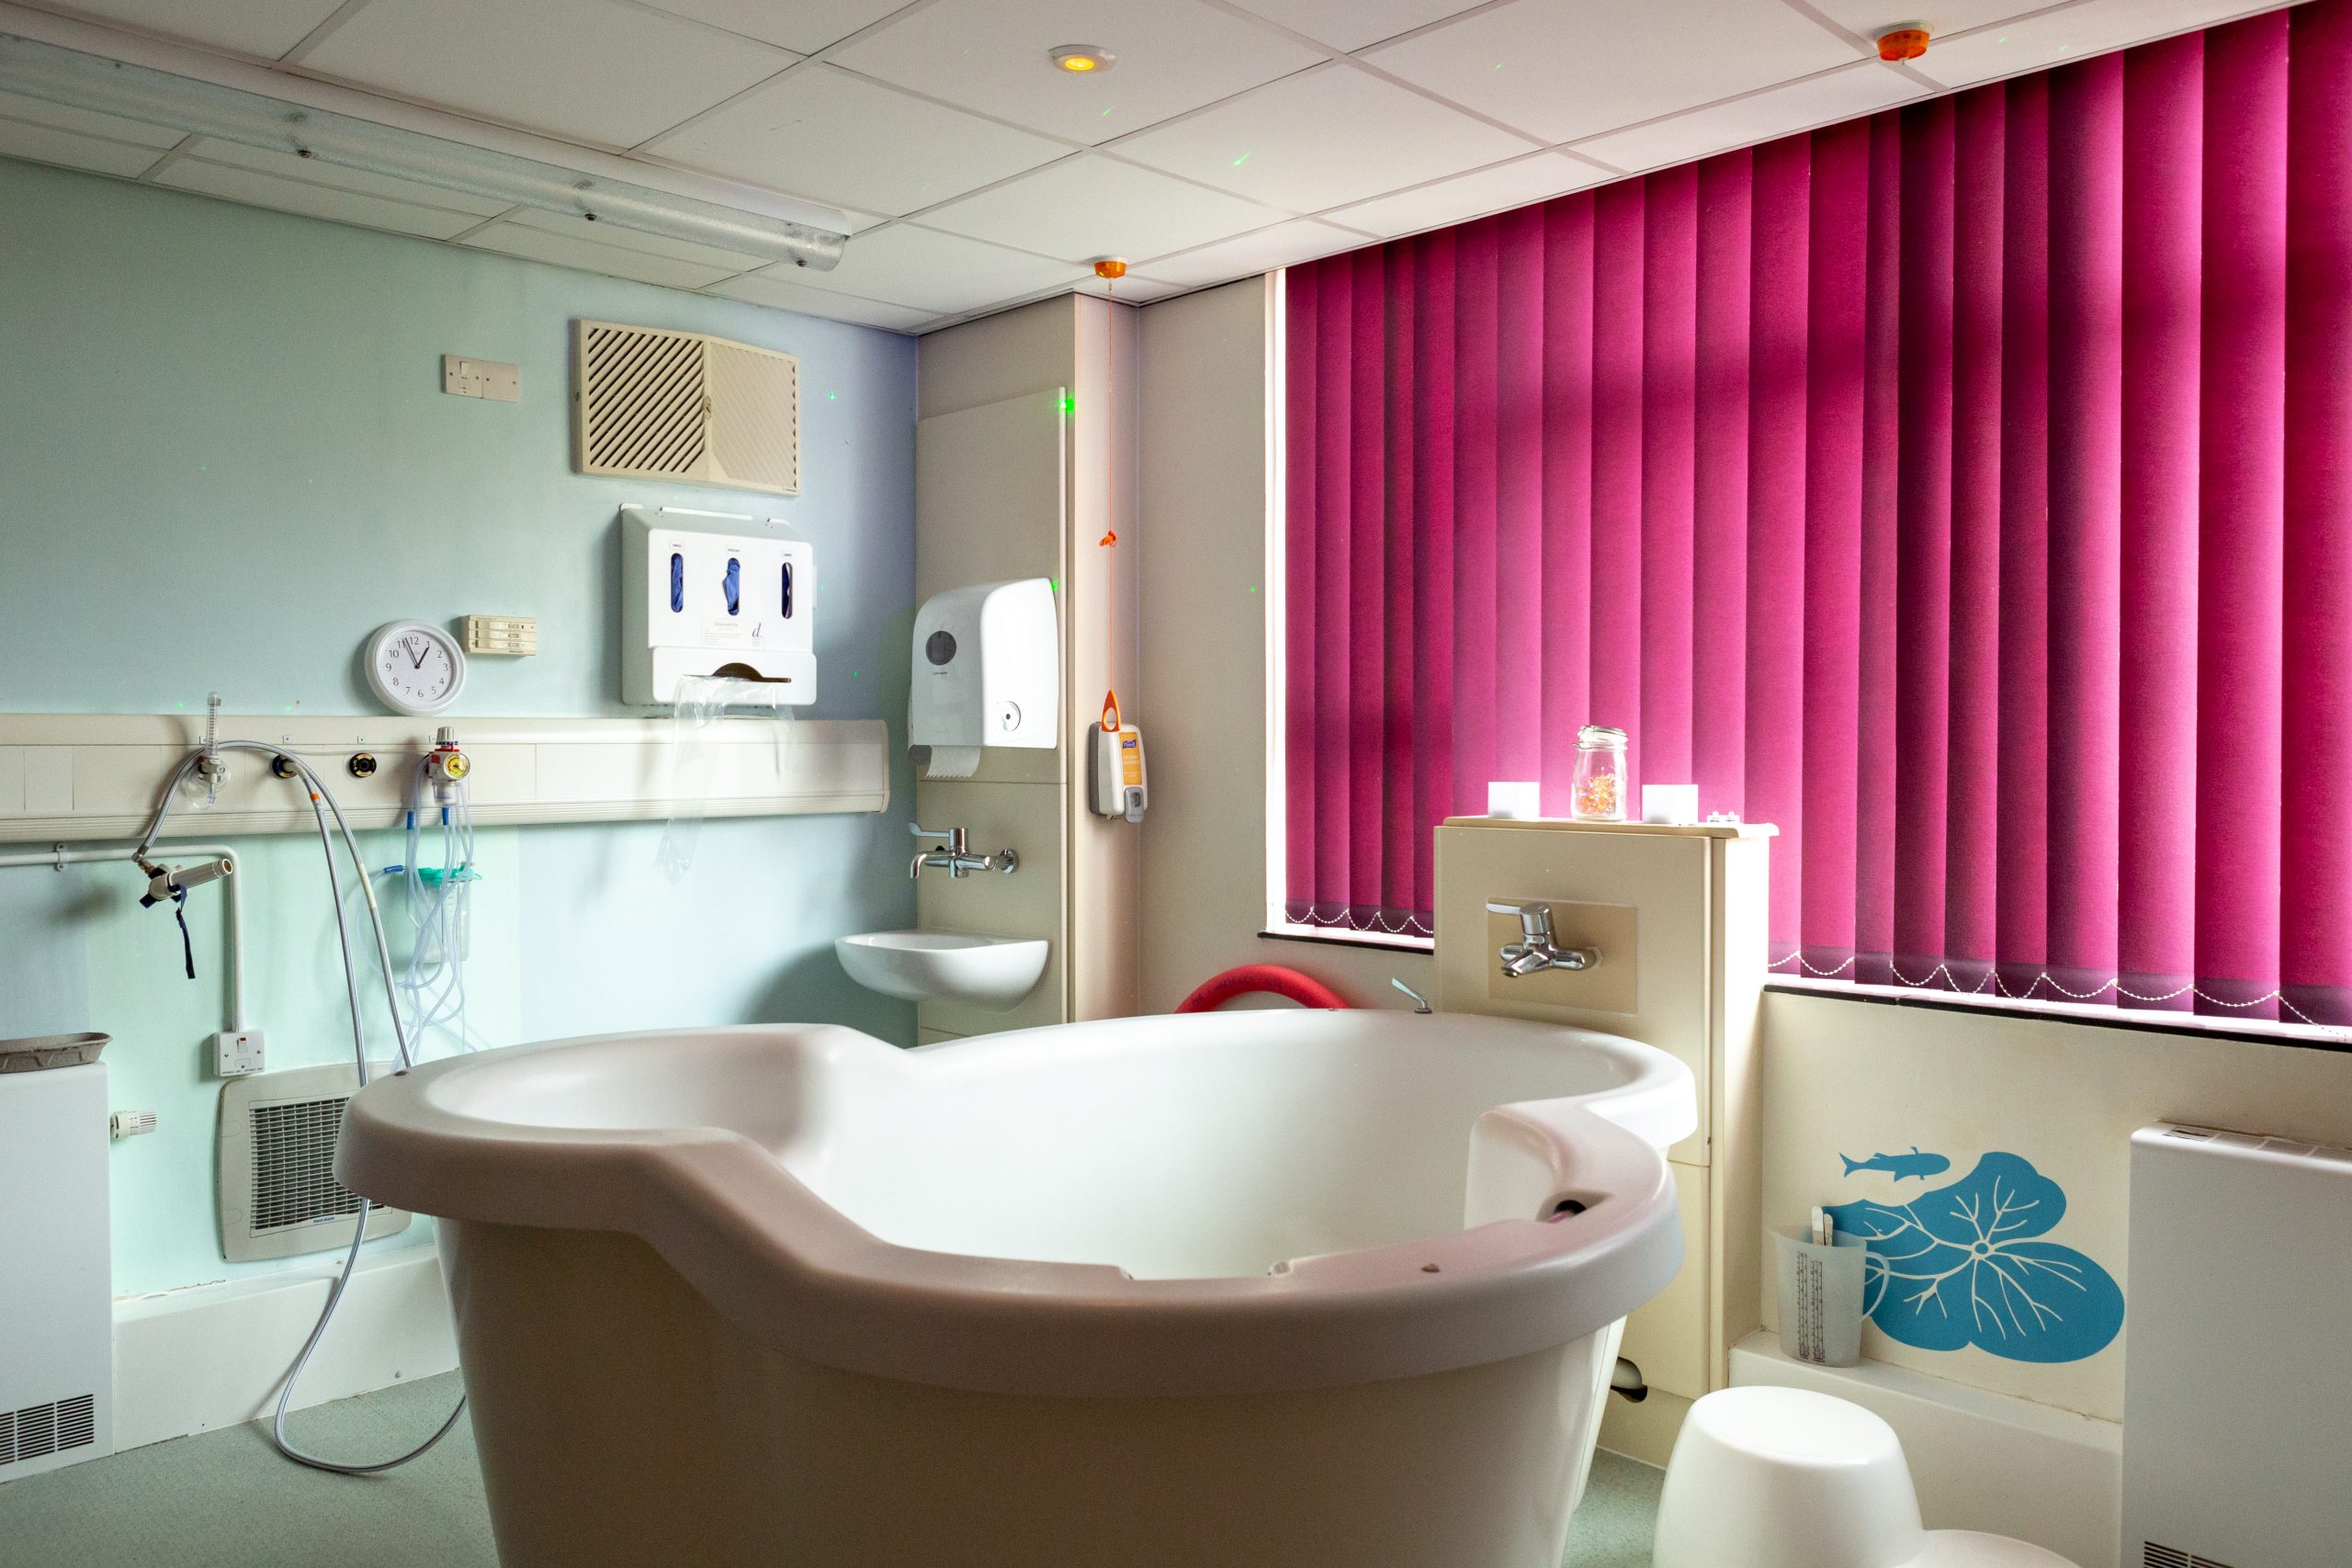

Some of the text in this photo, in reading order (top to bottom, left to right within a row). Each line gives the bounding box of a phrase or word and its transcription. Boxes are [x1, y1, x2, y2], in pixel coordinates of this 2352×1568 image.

[410, 637, 419, 645] 12
[436, 650, 442, 659] 2
[386, 663, 392, 671] 9
[443, 663, 448, 671] 3
[393, 678, 399, 686] 8
[405, 687, 411, 695] 7
